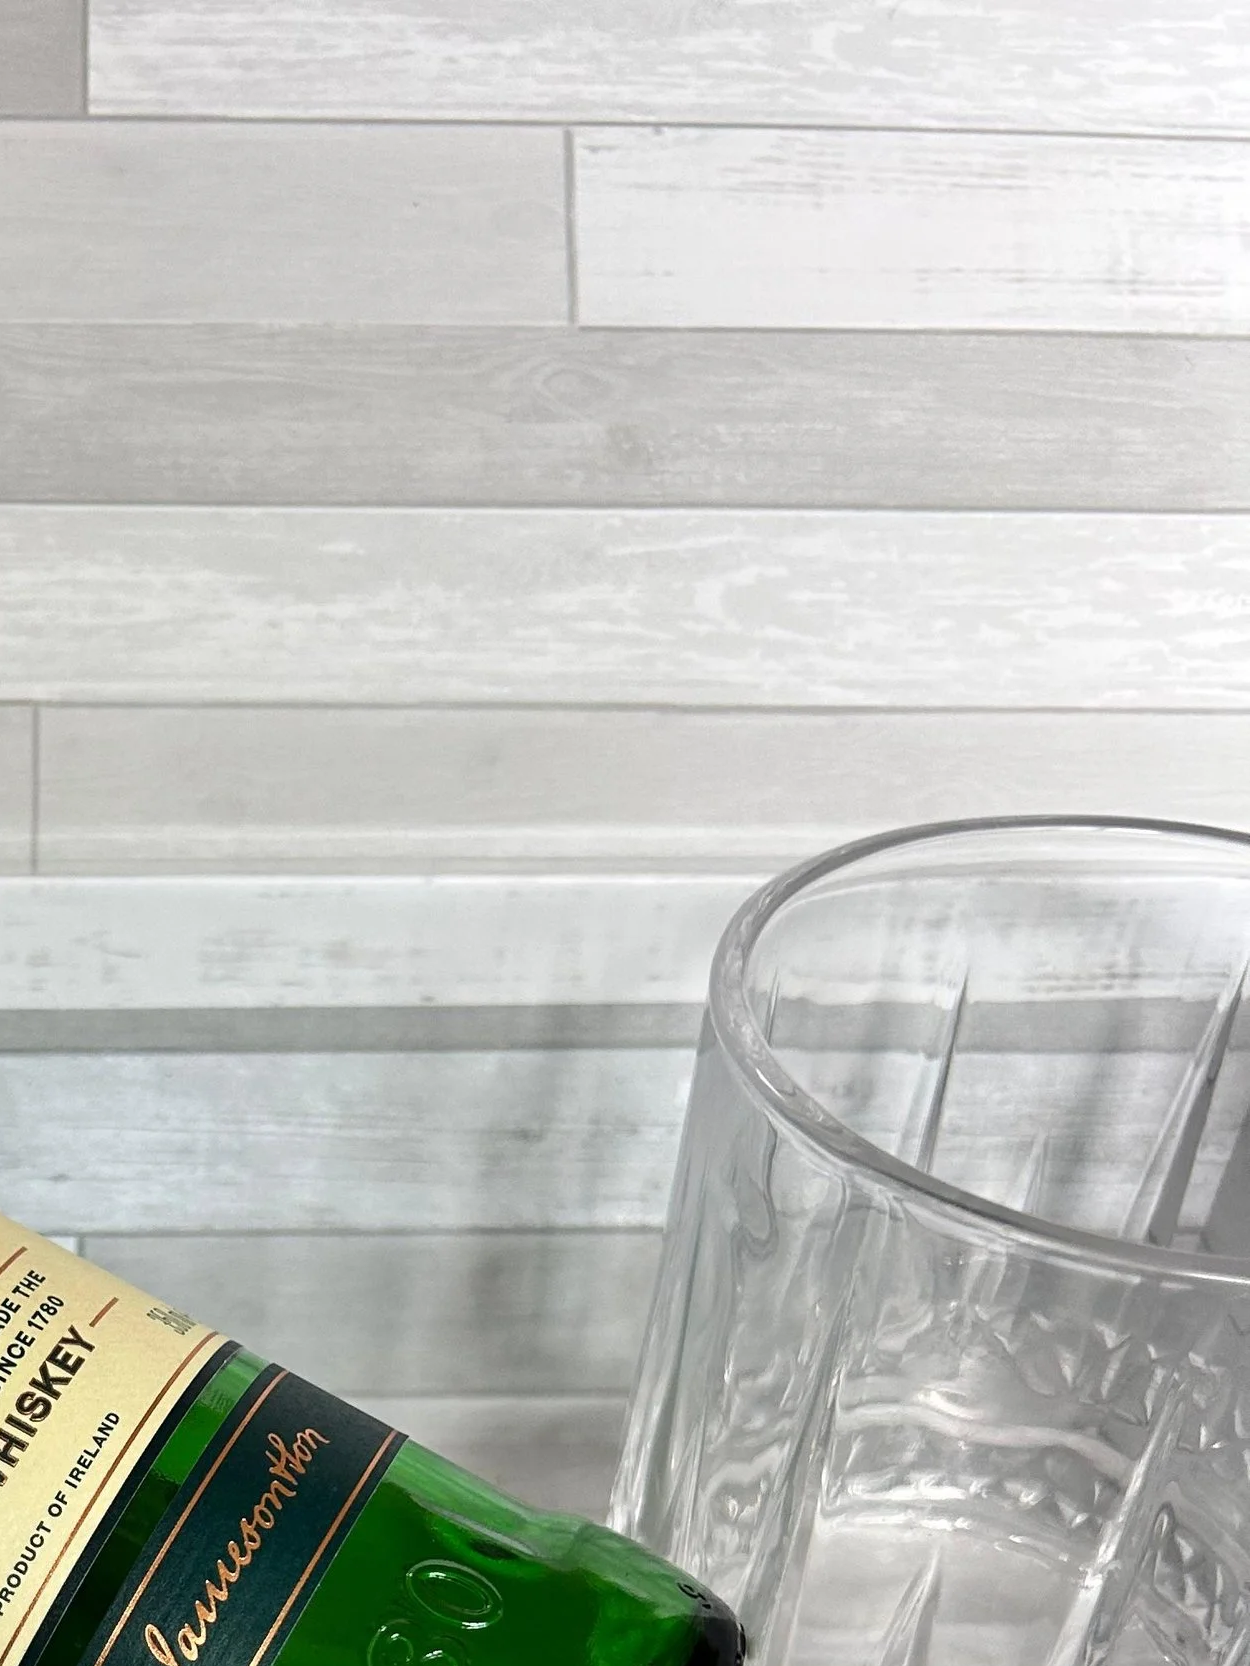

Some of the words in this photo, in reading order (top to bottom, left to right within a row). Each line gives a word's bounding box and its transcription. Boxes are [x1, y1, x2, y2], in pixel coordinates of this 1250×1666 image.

[12, 1269, 47, 1308] THE
[27, 1295, 66, 1336] 1780
[48, 1490, 68, 1518] OF
[64, 1412, 120, 1489] IRELAND
